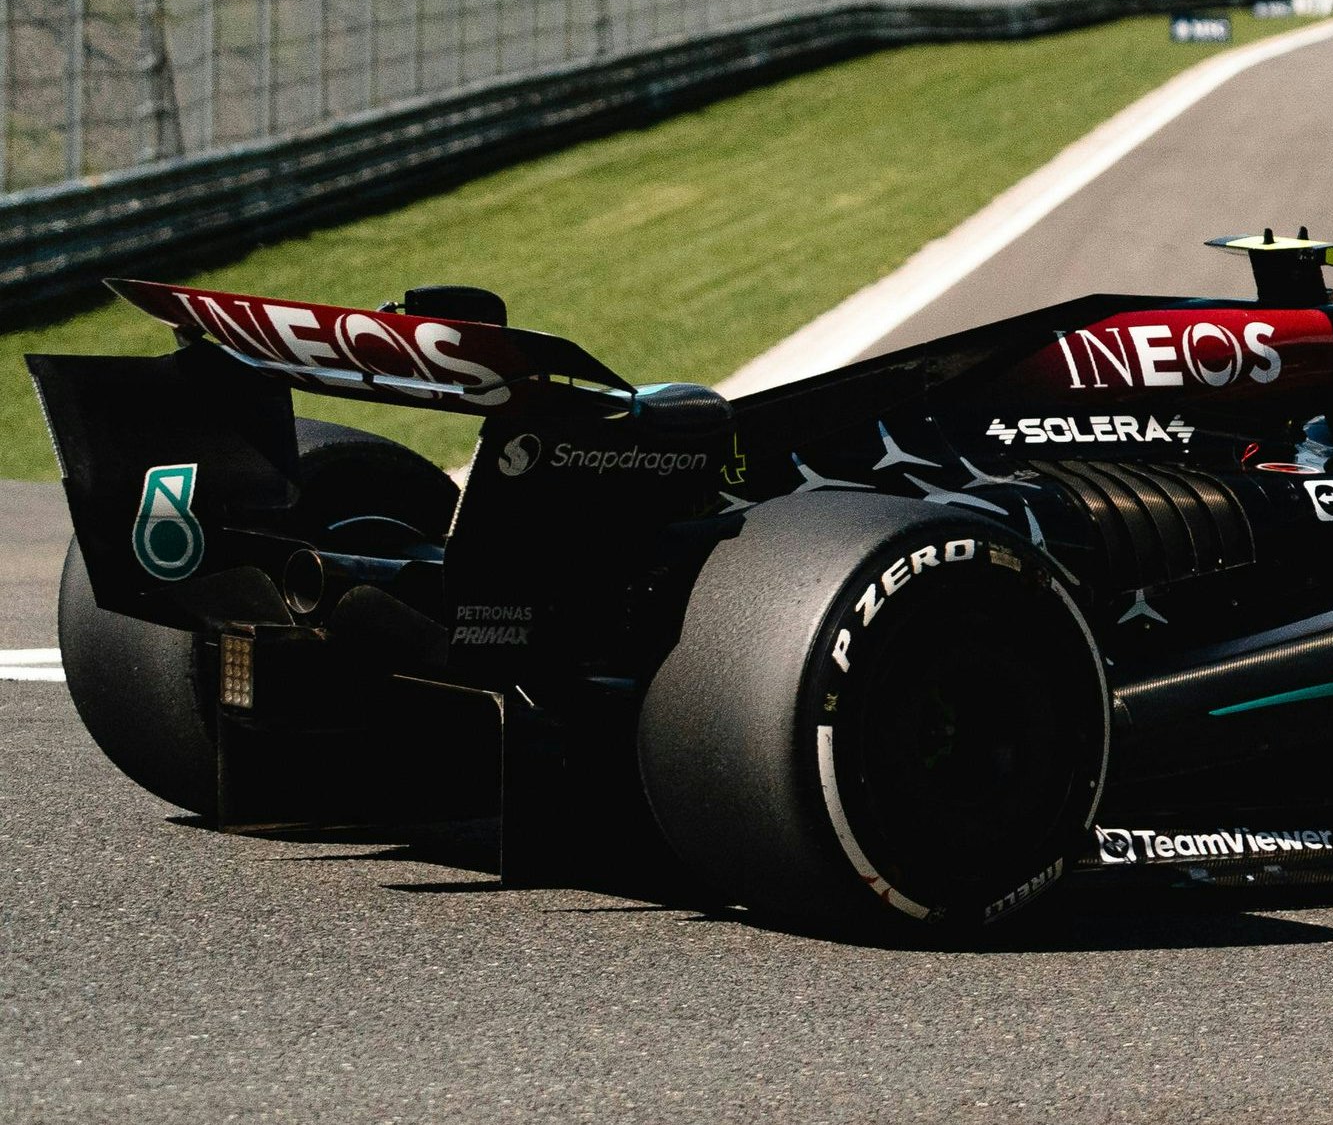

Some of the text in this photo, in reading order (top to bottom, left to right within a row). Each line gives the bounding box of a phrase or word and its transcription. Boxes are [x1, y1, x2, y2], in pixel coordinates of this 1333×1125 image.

[173, 292, 511, 406] INEOS
[1053, 322, 1281, 388] INEOS
[1017, 415, 1172, 444] SOLERA
[550, 443, 707, 476] Snapdragon
[456, 606, 532, 620] PETRONAS
[832, 628, 851, 673] P
[855, 539, 975, 627] ZERO
[450, 626, 529, 645] PRIMAX
[1131, 828, 1333, 858] TeamViewer
